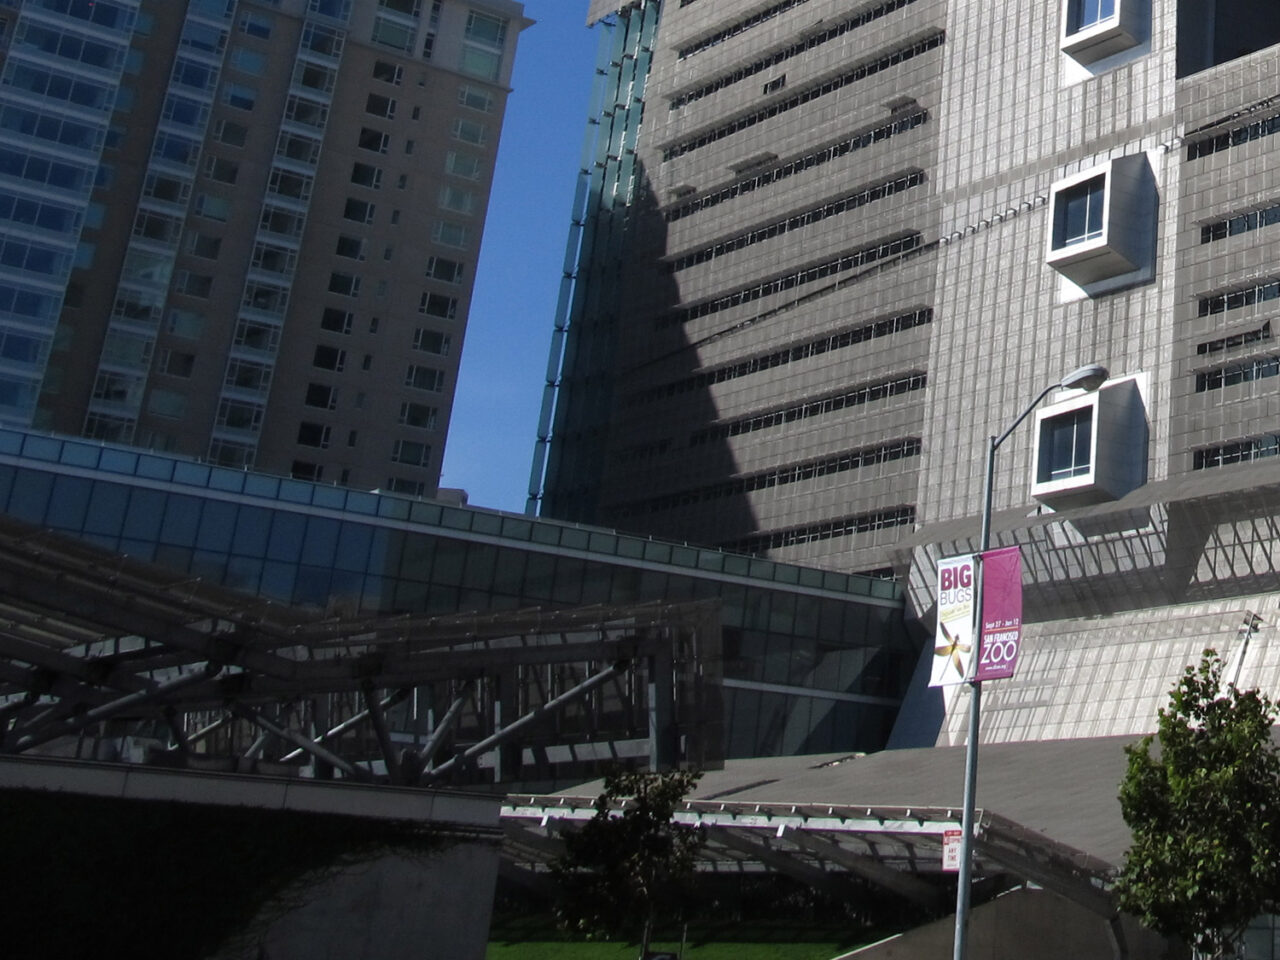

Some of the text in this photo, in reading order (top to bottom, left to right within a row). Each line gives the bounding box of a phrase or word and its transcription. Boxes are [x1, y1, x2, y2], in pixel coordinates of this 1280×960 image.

[941, 564, 972, 591] BIG
[940, 588, 972, 606] BUGS
[984, 631, 1019, 643] SAN FRANCISCO
[980, 640, 1017, 664] ZOO
